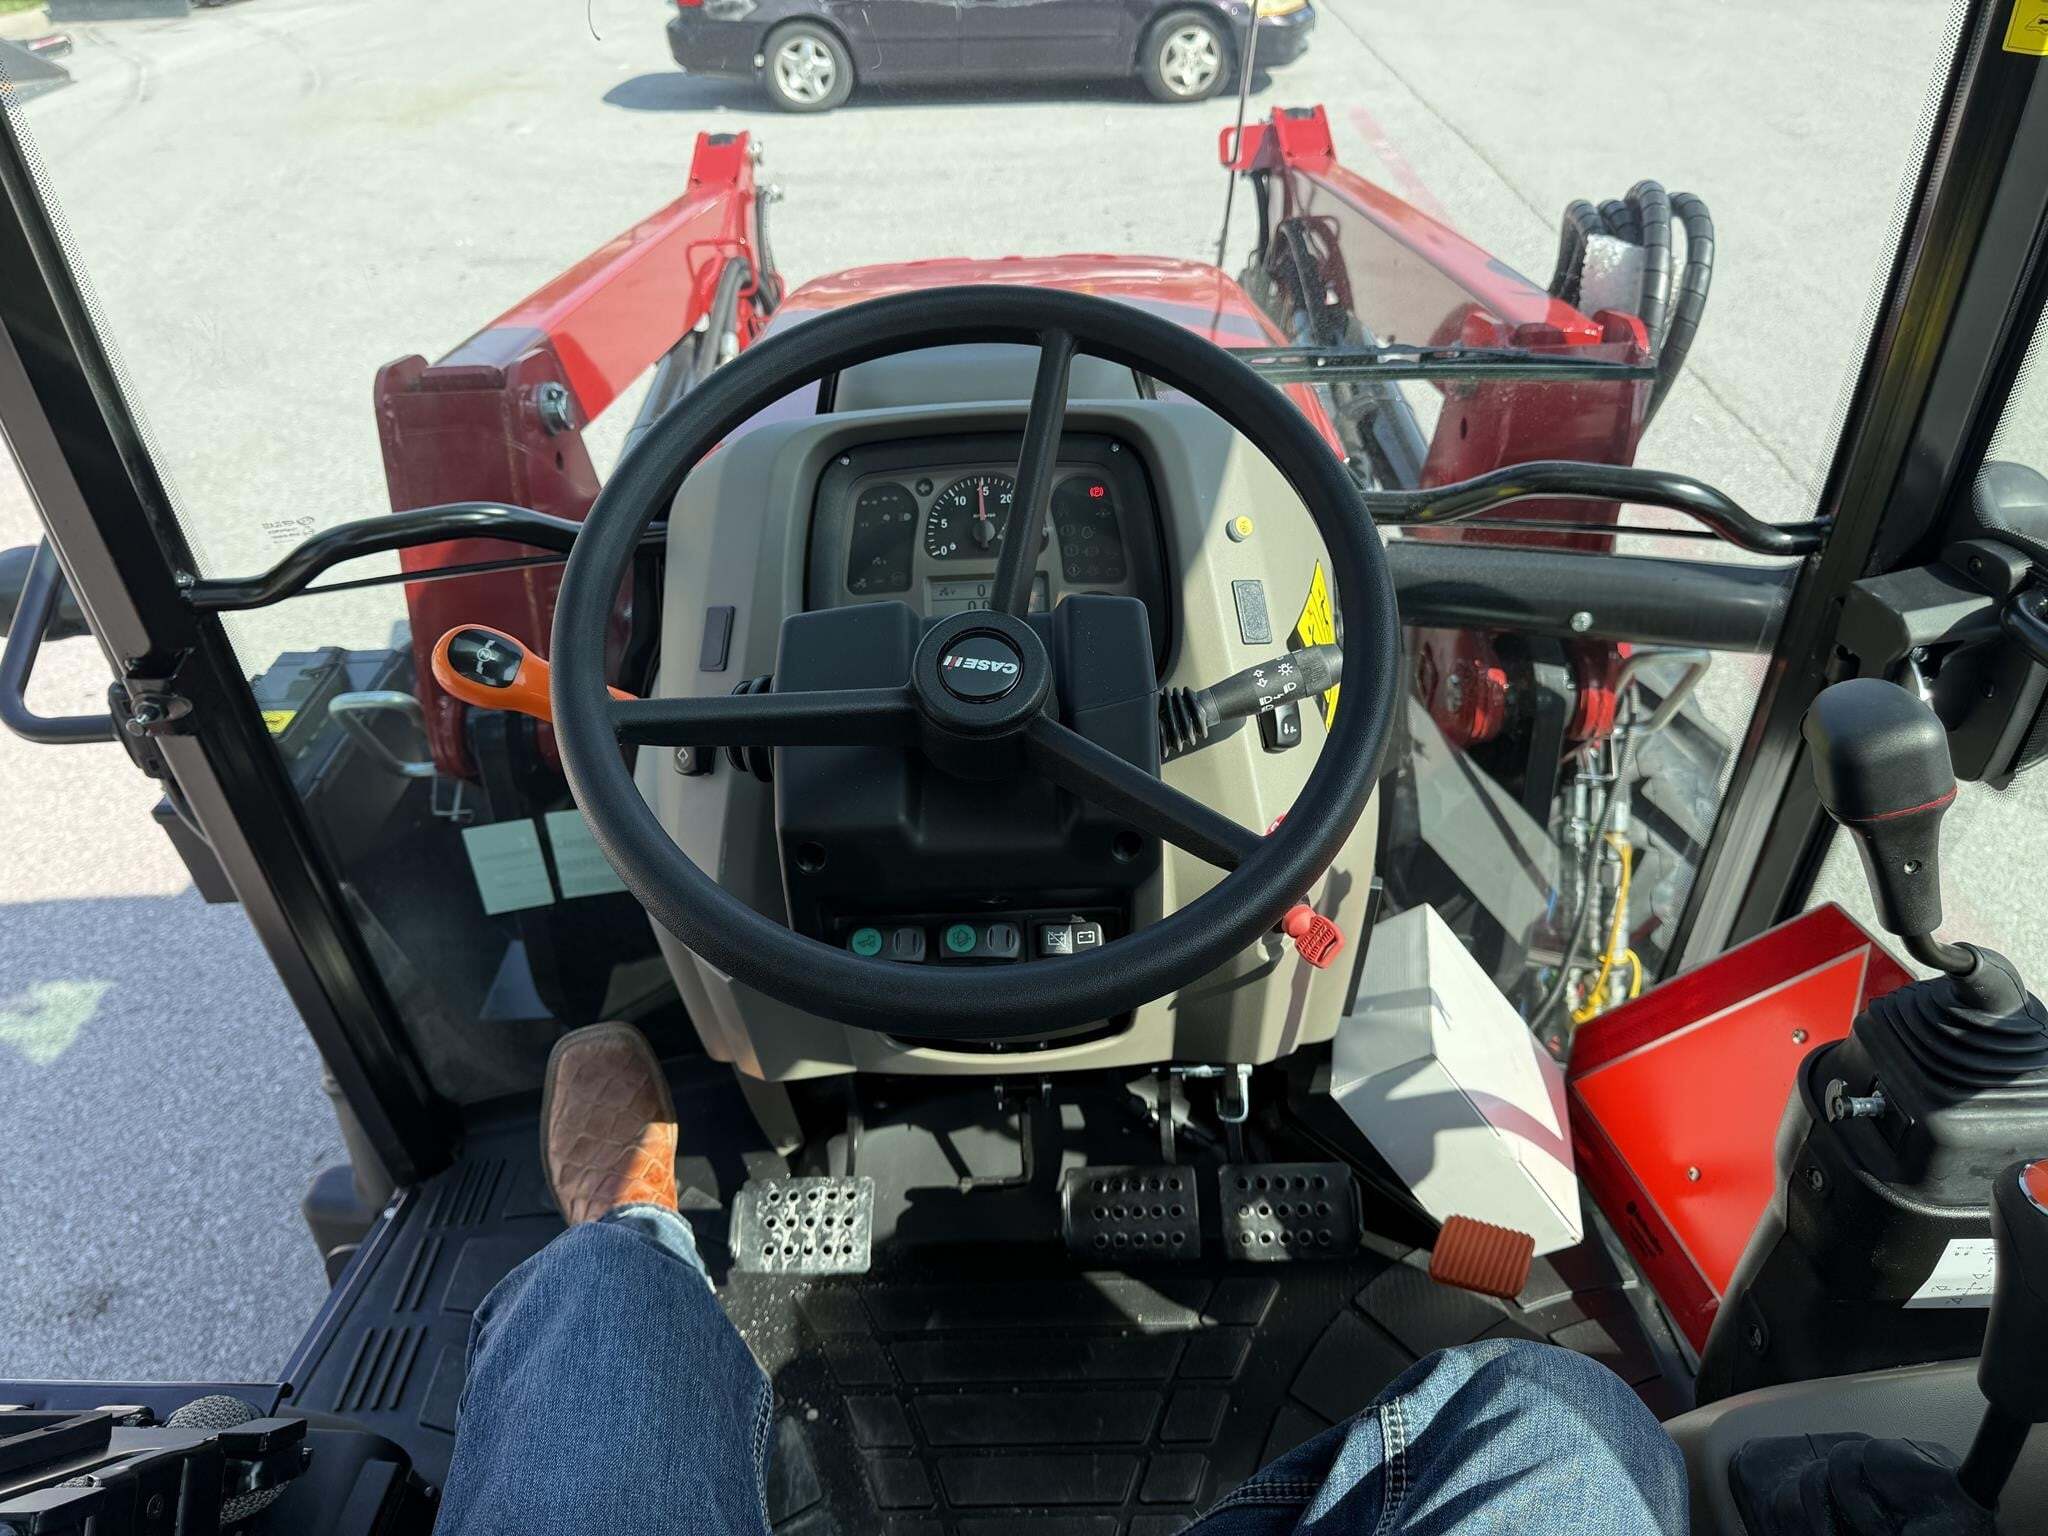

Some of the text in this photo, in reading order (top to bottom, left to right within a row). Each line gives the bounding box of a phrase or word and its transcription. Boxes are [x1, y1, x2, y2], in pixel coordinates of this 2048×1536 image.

[954, 495, 967, 506] 10
[1000, 494, 1012, 504] 20
[941, 518, 948, 528] 5
[940, 545, 948, 555] 0
[962, 657, 1018, 674] CASE
